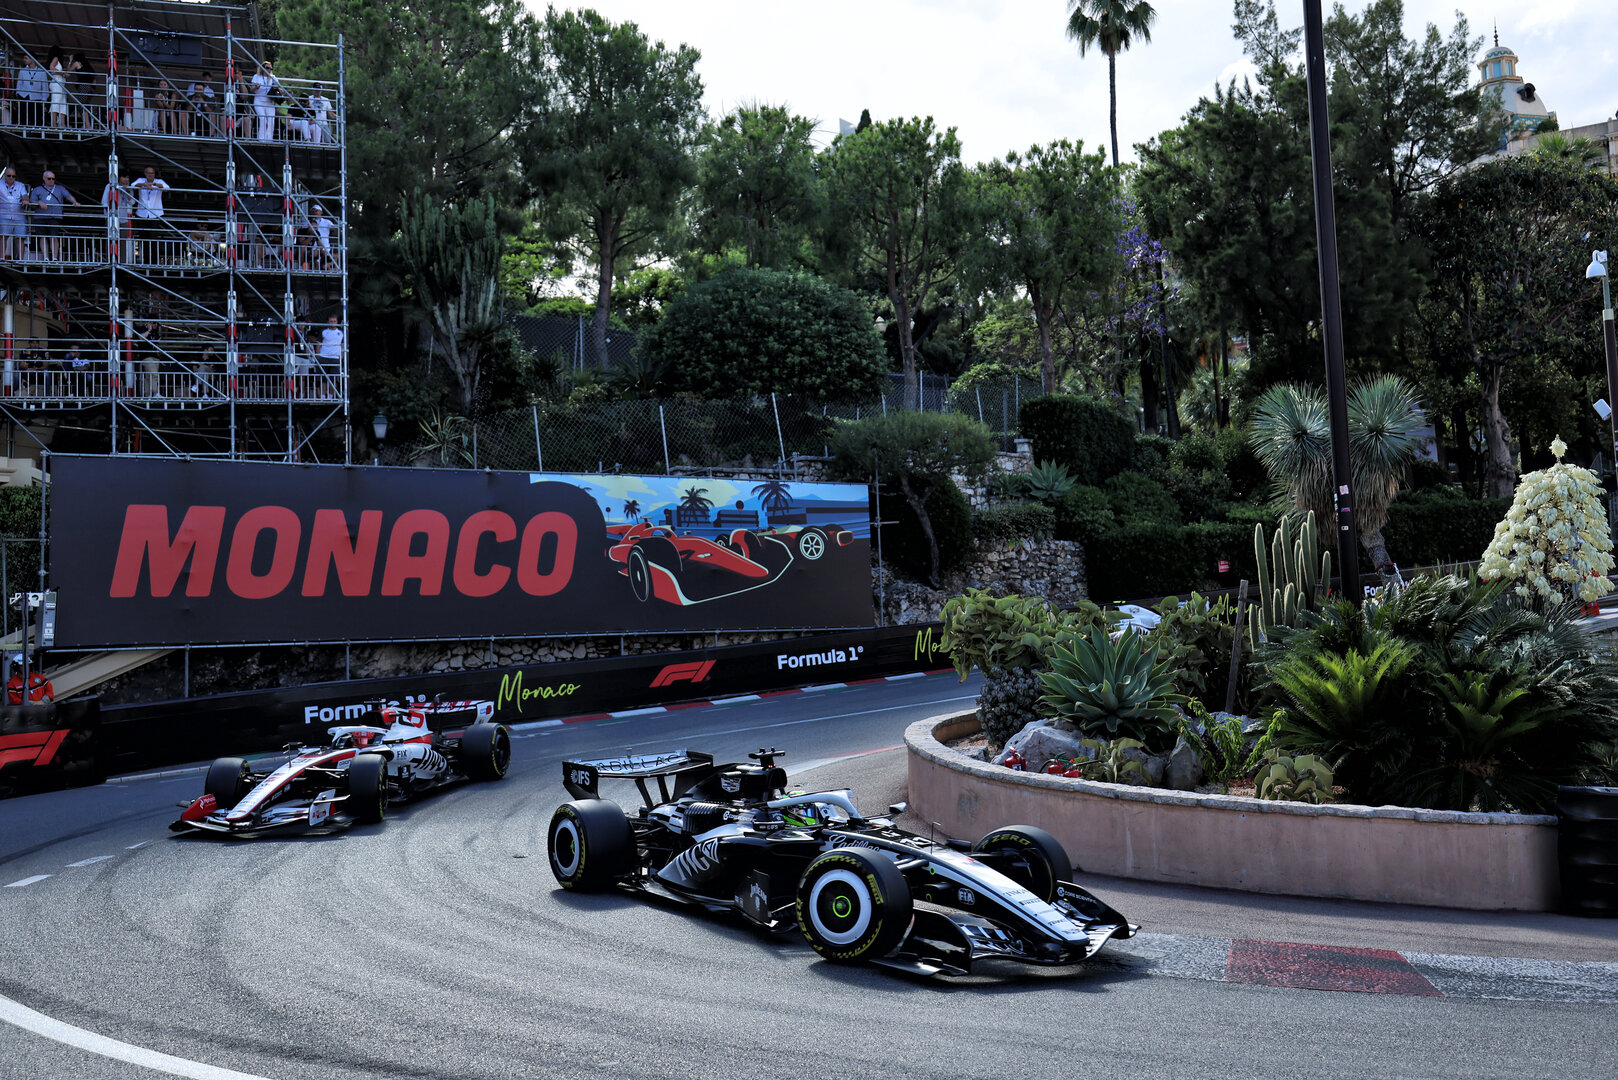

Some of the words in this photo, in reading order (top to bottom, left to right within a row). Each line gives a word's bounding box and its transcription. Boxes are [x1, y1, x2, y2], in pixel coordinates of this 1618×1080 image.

[109, 504, 578, 599] MONACO
[777, 649, 847, 669] Formula
[497, 670, 581, 713] Monaco
[578, 770, 591, 786] IFS
[828, 833, 881, 853] Cadillac
[992, 833, 1032, 846] ZERO
[958, 890, 974, 904] FIA
